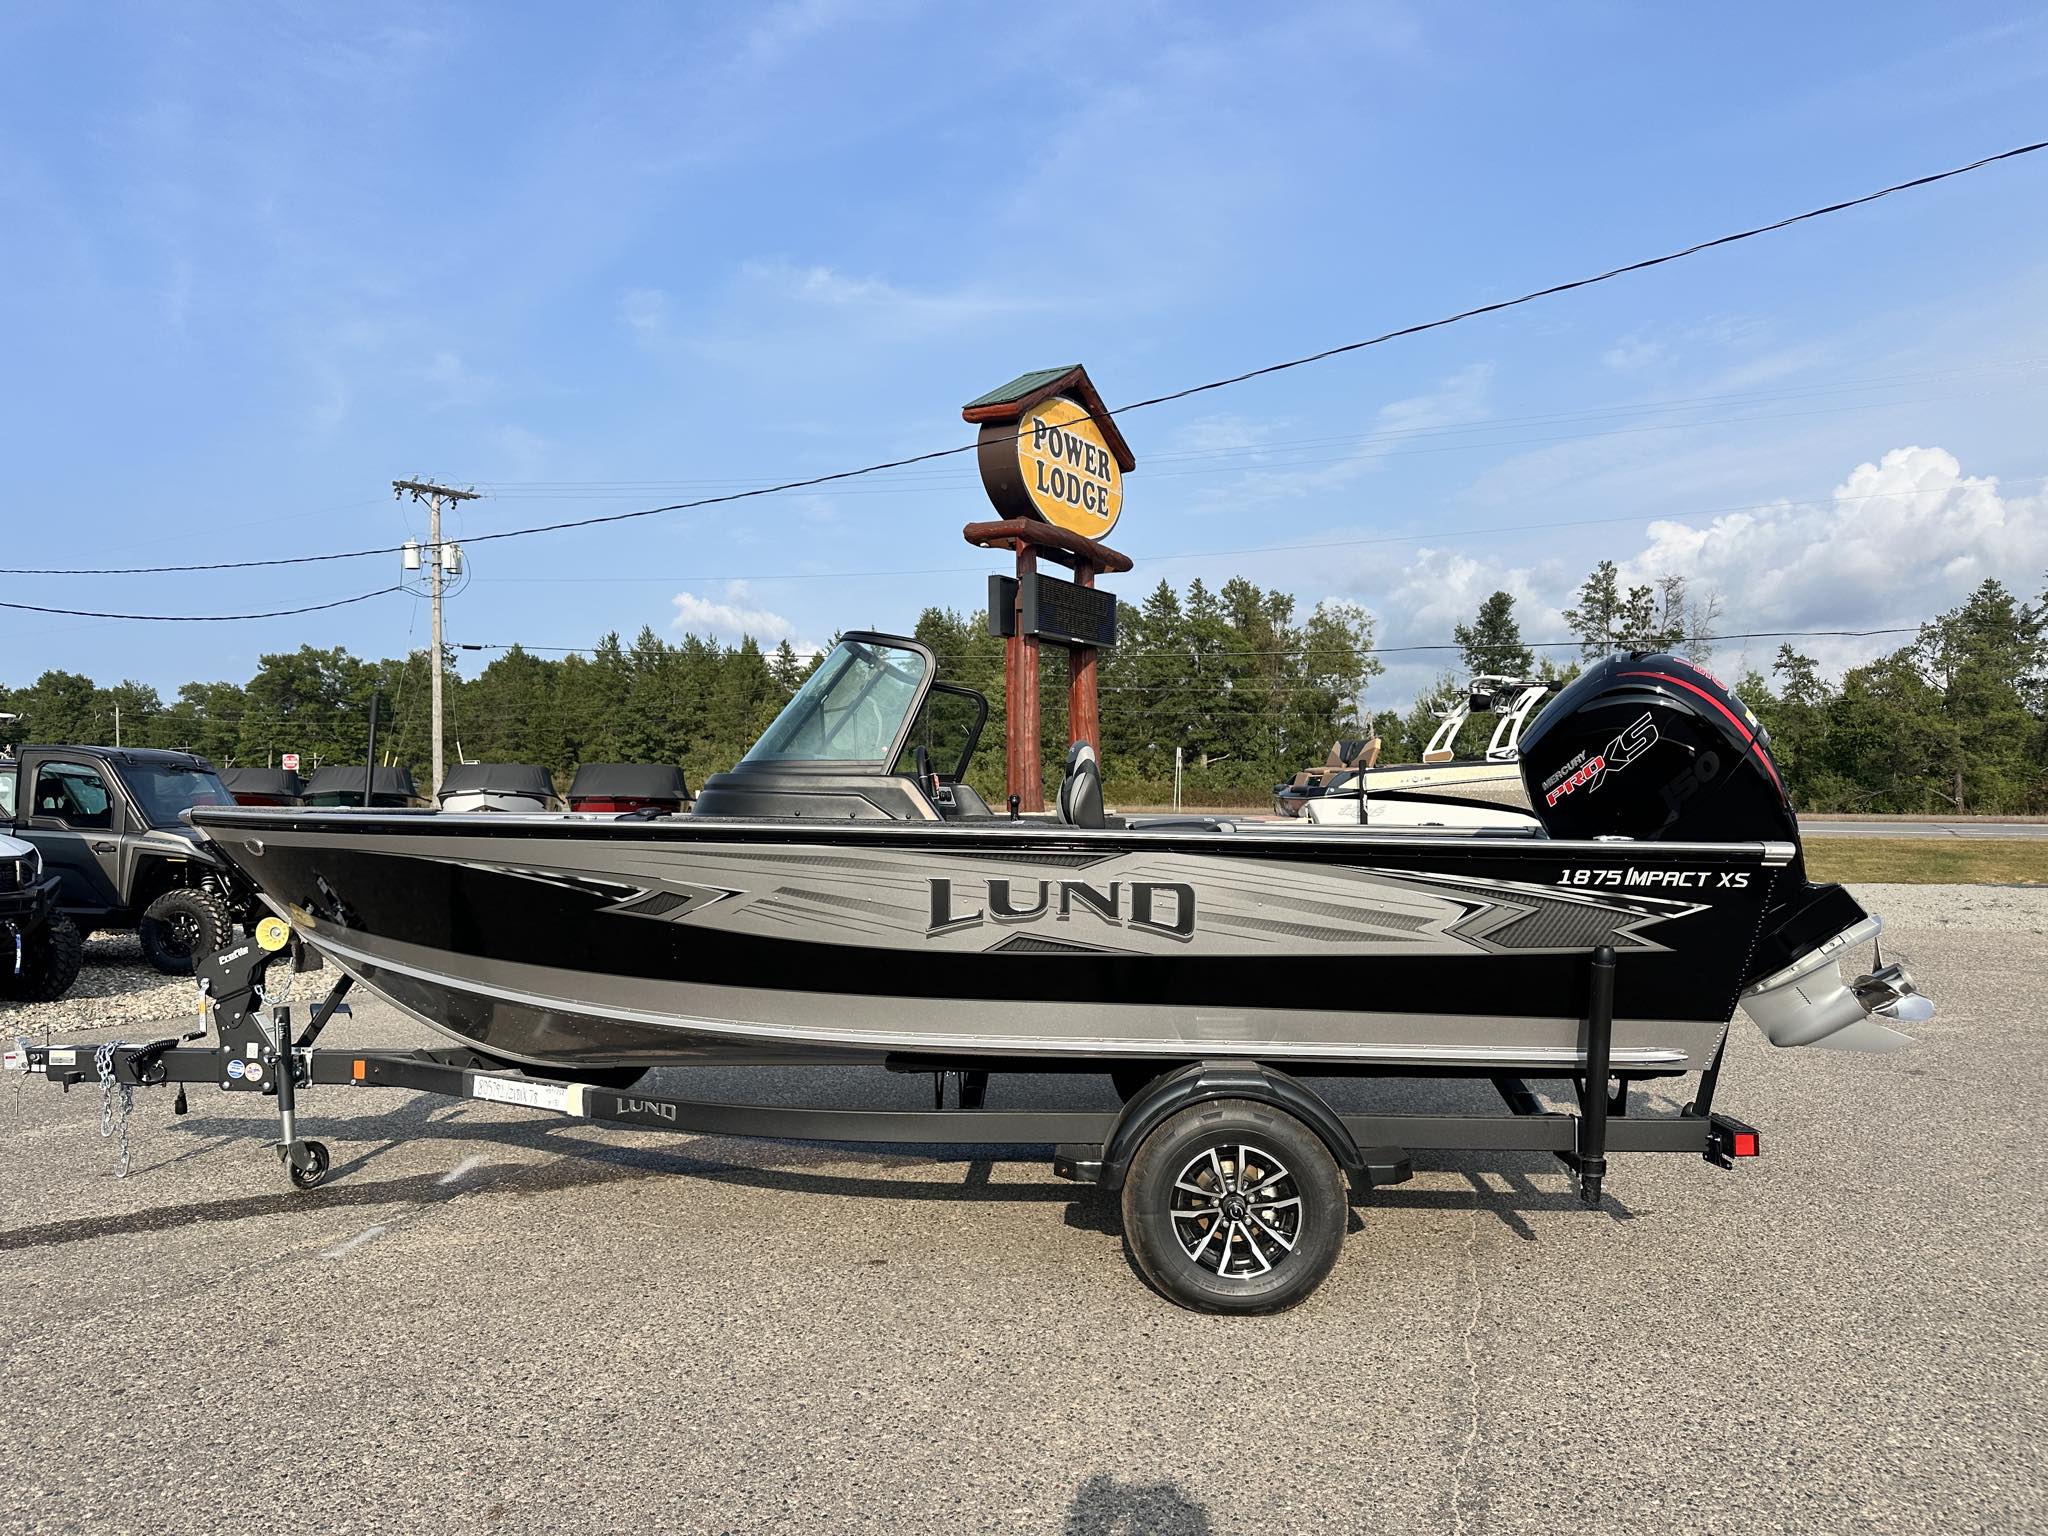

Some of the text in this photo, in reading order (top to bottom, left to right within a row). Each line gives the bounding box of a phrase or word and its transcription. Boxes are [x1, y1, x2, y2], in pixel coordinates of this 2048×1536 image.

[1033, 417, 1110, 482] POWER
[1036, 459, 1109, 517] LODGE
[1541, 749, 1586, 791] MERCURY
[1545, 711, 1659, 807] PRO XS
[1556, 866, 1751, 888] 1875 IMPACT XS
[926, 878, 1195, 942] LUND
[616, 1097, 676, 1121] LUND
